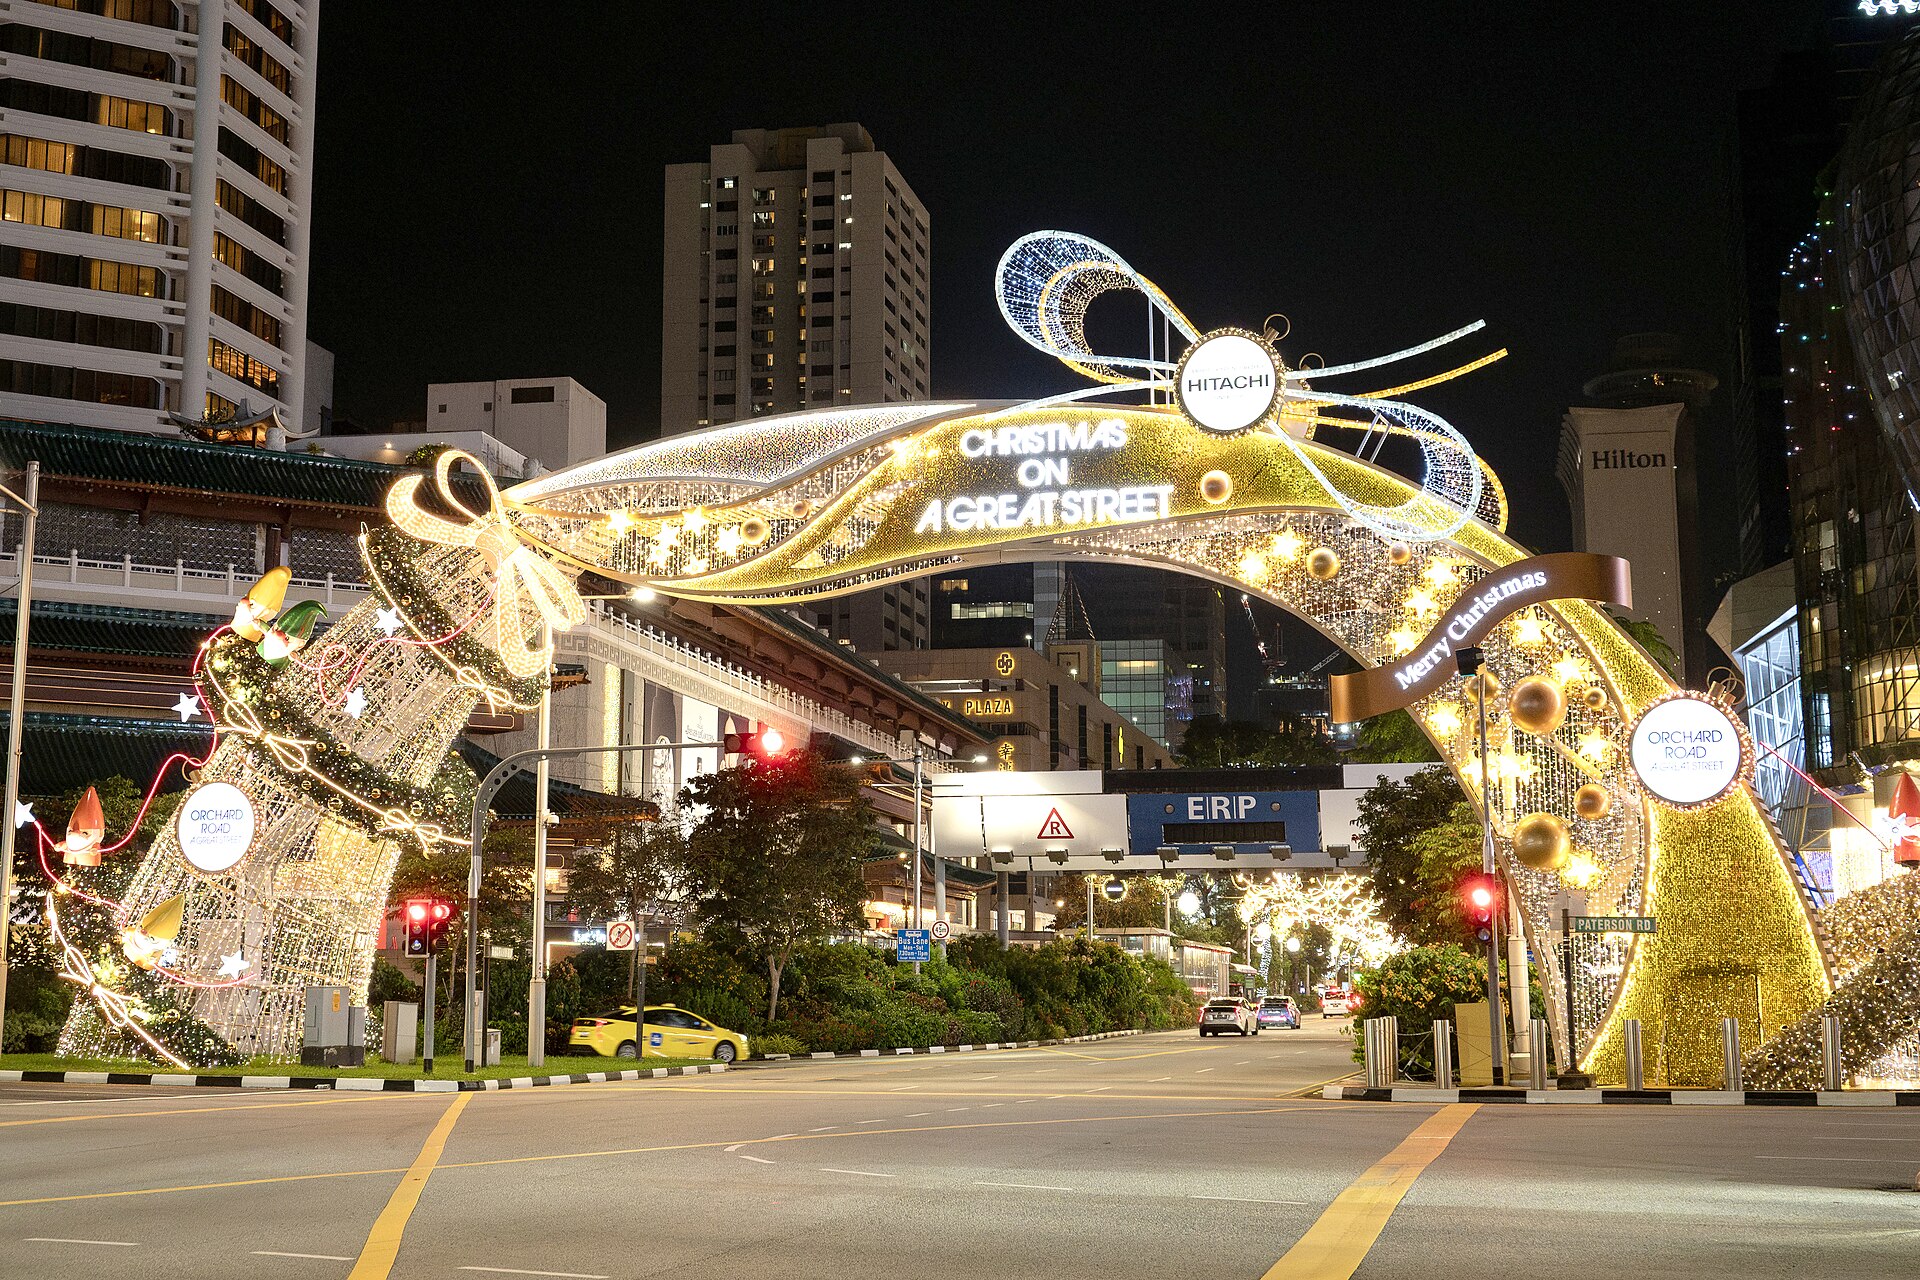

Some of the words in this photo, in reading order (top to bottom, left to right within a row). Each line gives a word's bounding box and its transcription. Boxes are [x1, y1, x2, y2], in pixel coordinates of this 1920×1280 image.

[1188, 374, 1269, 392] HITACHI
[960, 419, 1128, 458] CHRISTMAS
[1592, 449, 1667, 470] Hilton
[1017, 457, 1069, 487] ON
[914, 499, 943, 533] A
[947, 491, 1058, 530] GREAT
[1060, 484, 1174, 524] STREET
[1394, 636, 1451, 690] Merry
[1447, 571, 1547, 640] Christmas
[965, 699, 1012, 714] PLAZA
[1648, 730, 1723, 744] ORCHARD
[1665, 746, 1707, 759] ROAD
[190, 809, 244, 821] ORCHARD
[201, 823, 231, 834] ROAD
[1050, 821, 1061, 835] R
[1578, 919, 1632, 931] PATERSON
[1636, 919, 1651, 931] RD
[898, 937, 911, 945] Bus
[912, 937, 929, 945] Lane
